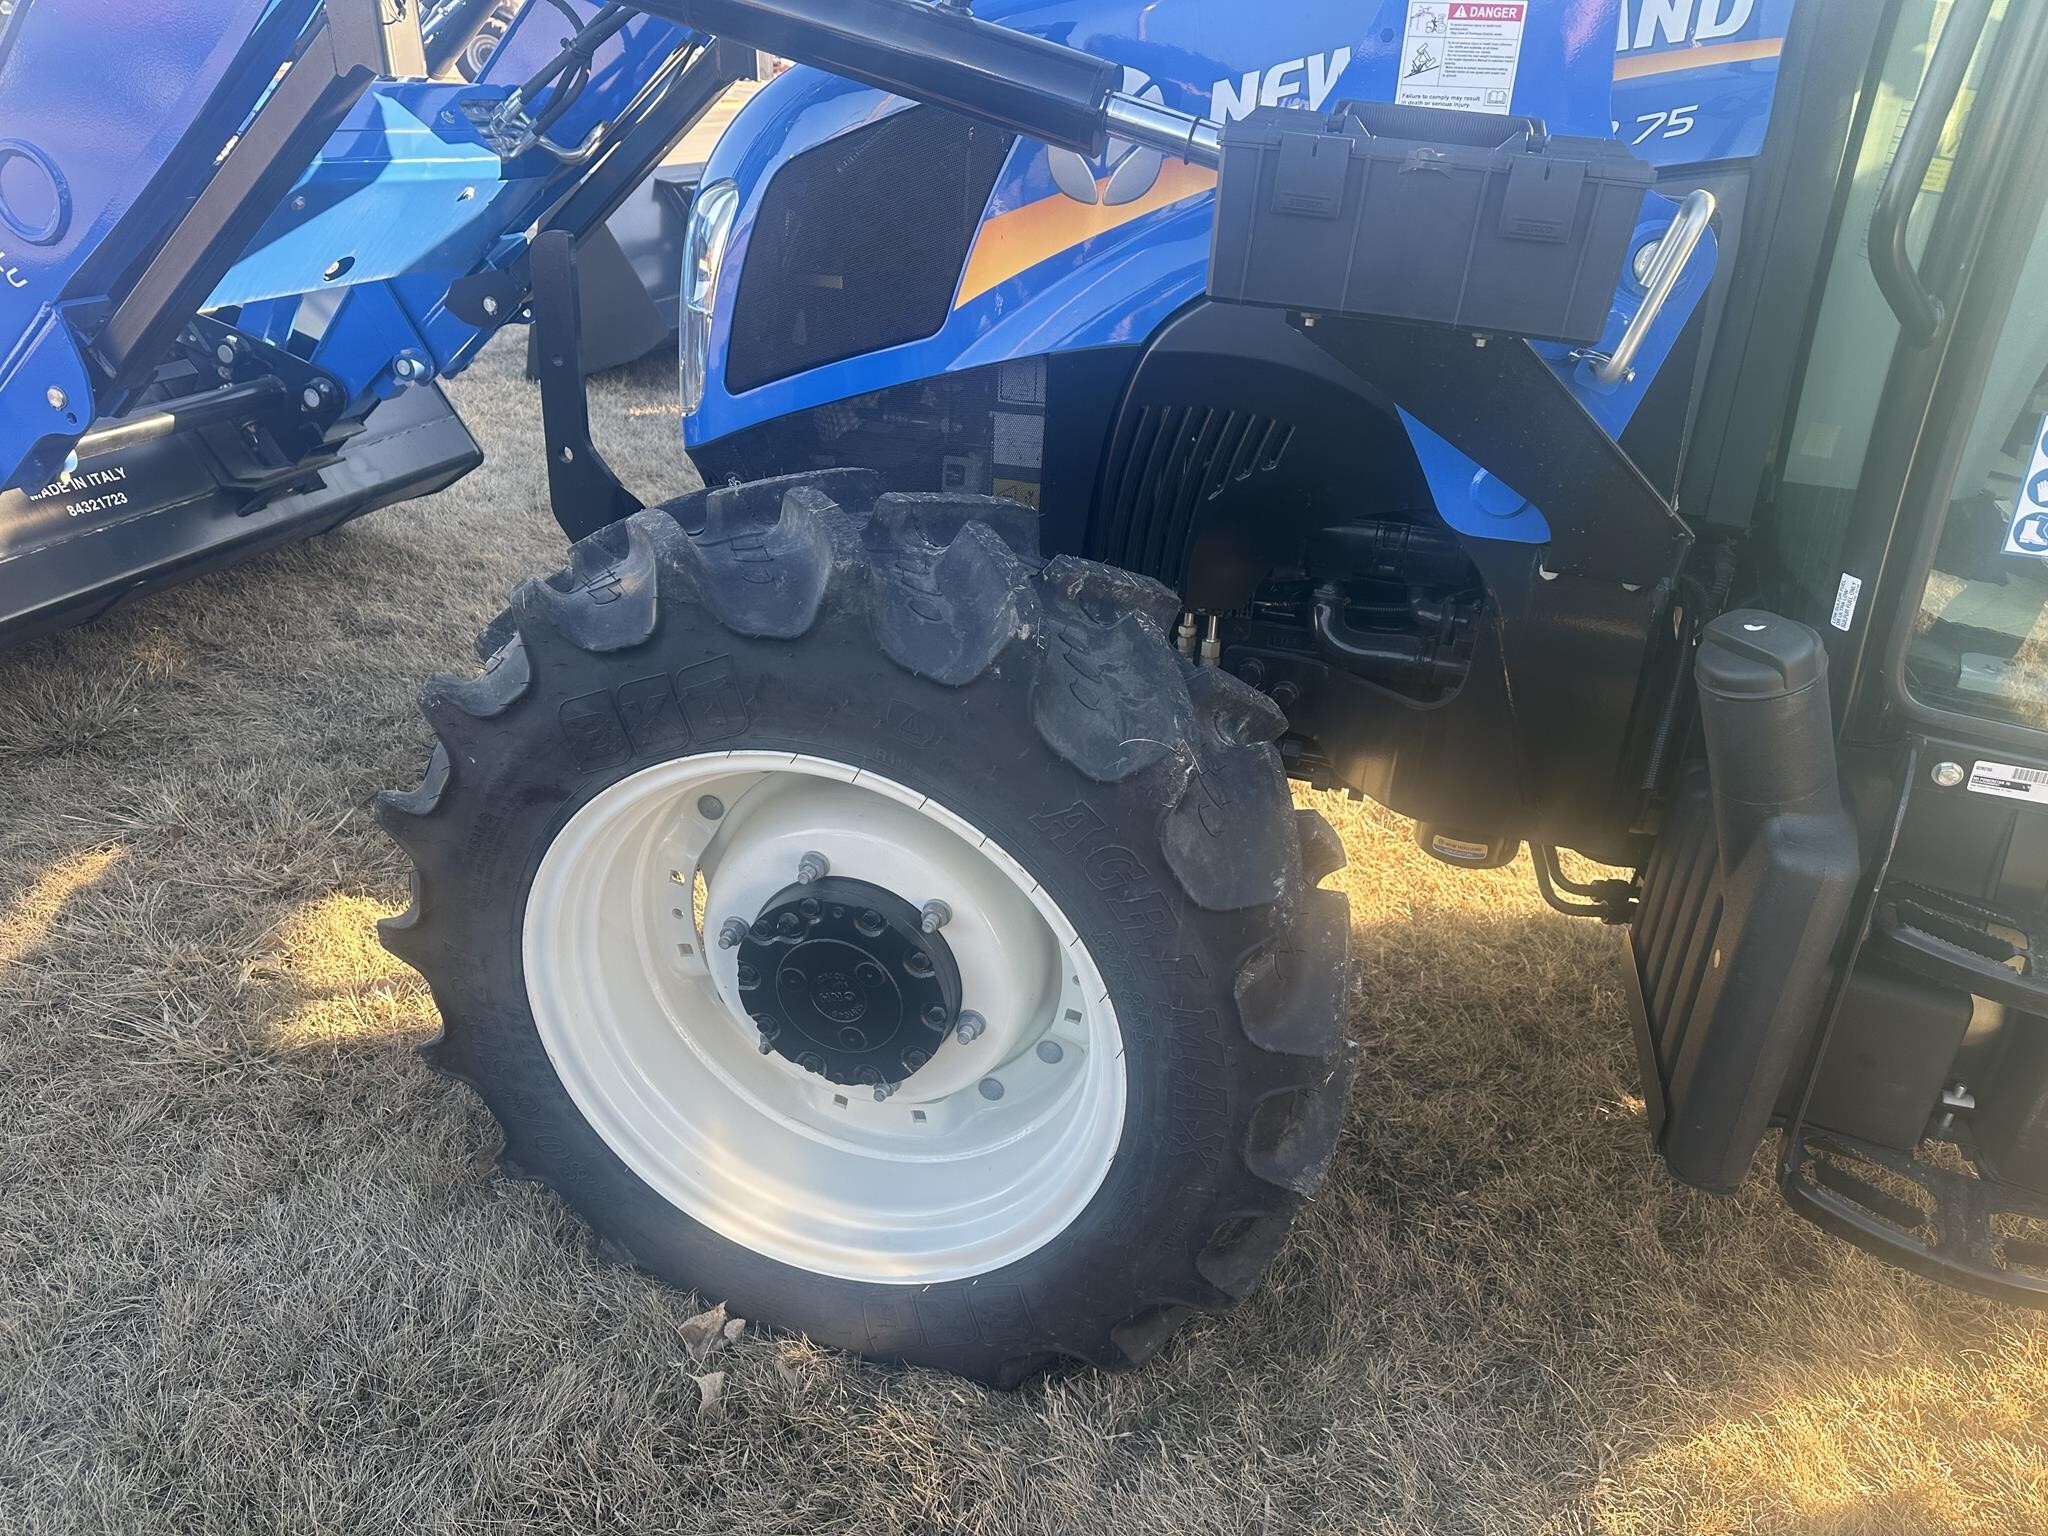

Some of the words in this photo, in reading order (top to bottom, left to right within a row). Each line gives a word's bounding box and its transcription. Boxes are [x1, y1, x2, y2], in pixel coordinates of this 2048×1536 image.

[1469, 6, 1518, 19] DANGER
[1616, 0, 1754, 51] ND
[1632, 105, 1699, 145] 75
[70, 475, 87, 491] IN
[87, 467, 126, 486] ITALY
[66, 492, 128, 517] 84321723
